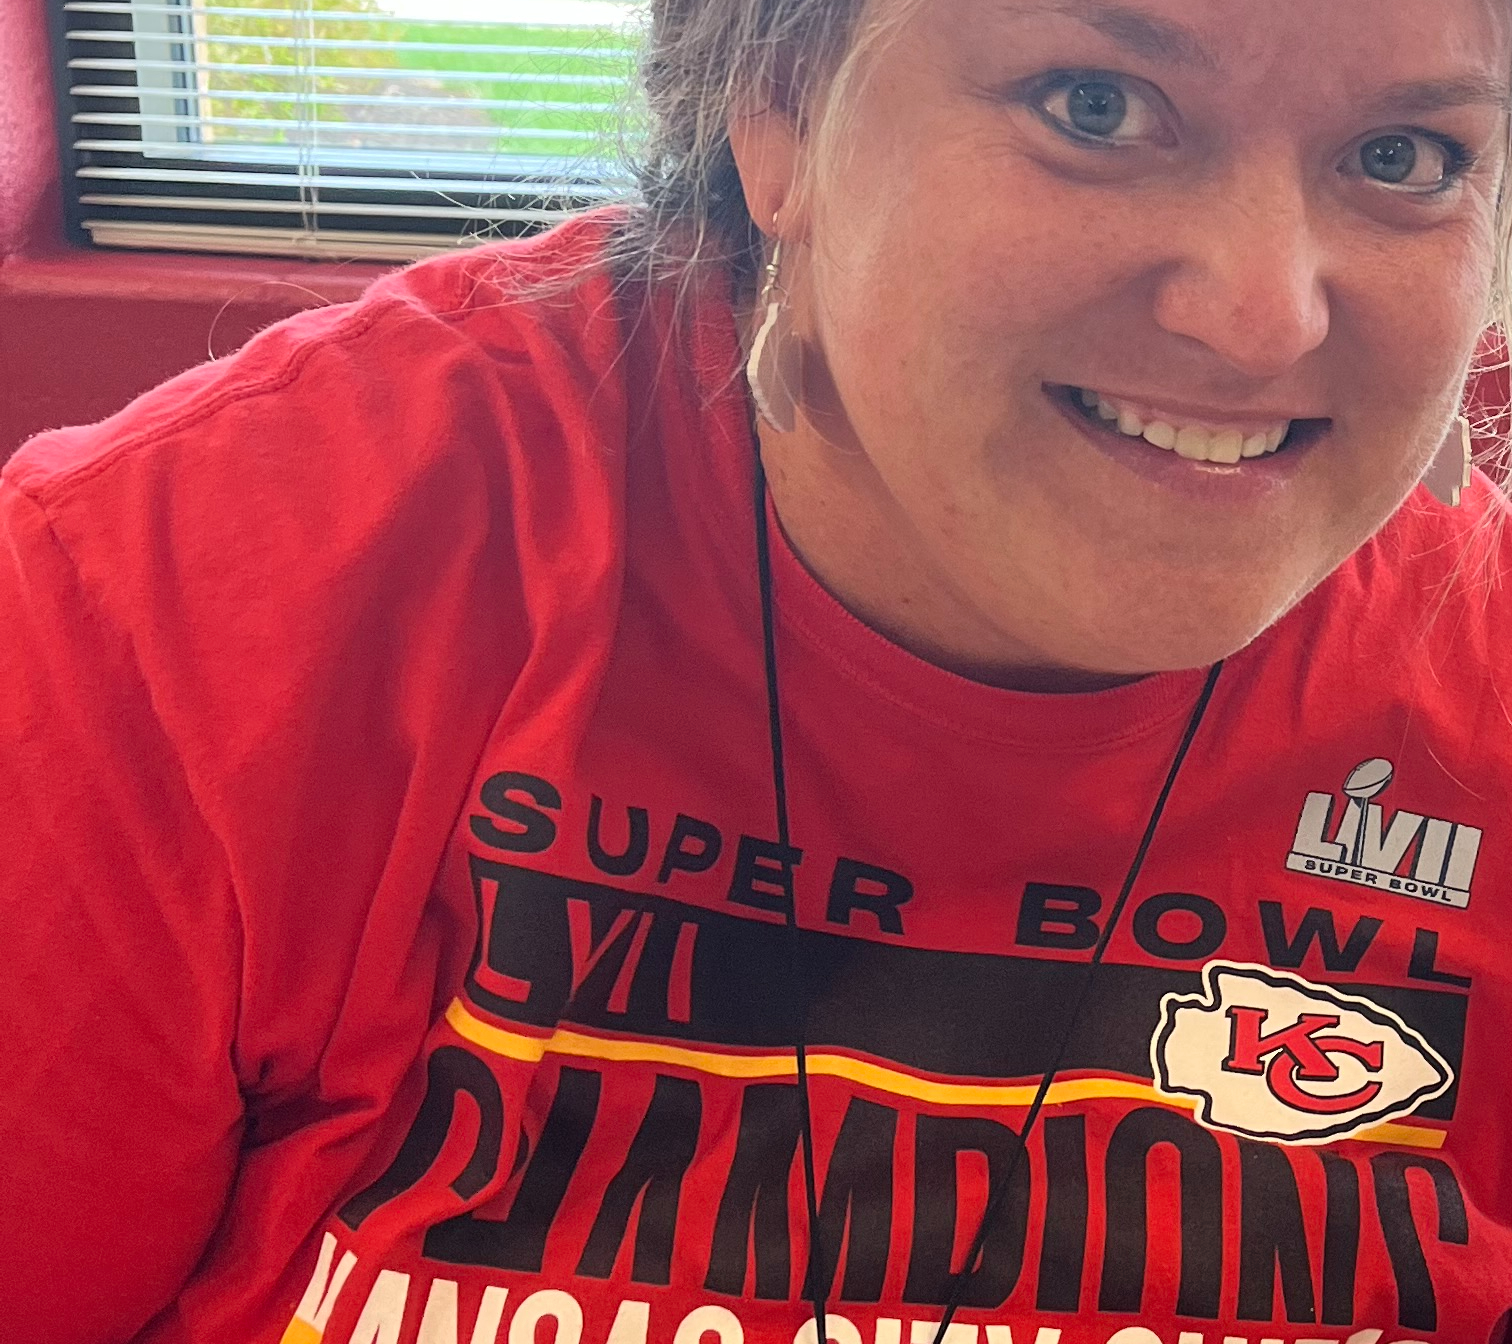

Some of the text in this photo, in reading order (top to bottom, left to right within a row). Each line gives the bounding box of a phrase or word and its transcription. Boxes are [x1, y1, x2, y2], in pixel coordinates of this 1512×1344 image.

[468, 770, 1474, 989] SUPER BOWL
[1291, 790, 1484, 892] LVII
[1304, 859, 1452, 902] SUPER BOWL
[472, 877, 699, 1024] LVII
[1221, 1005, 1385, 1116] KC
